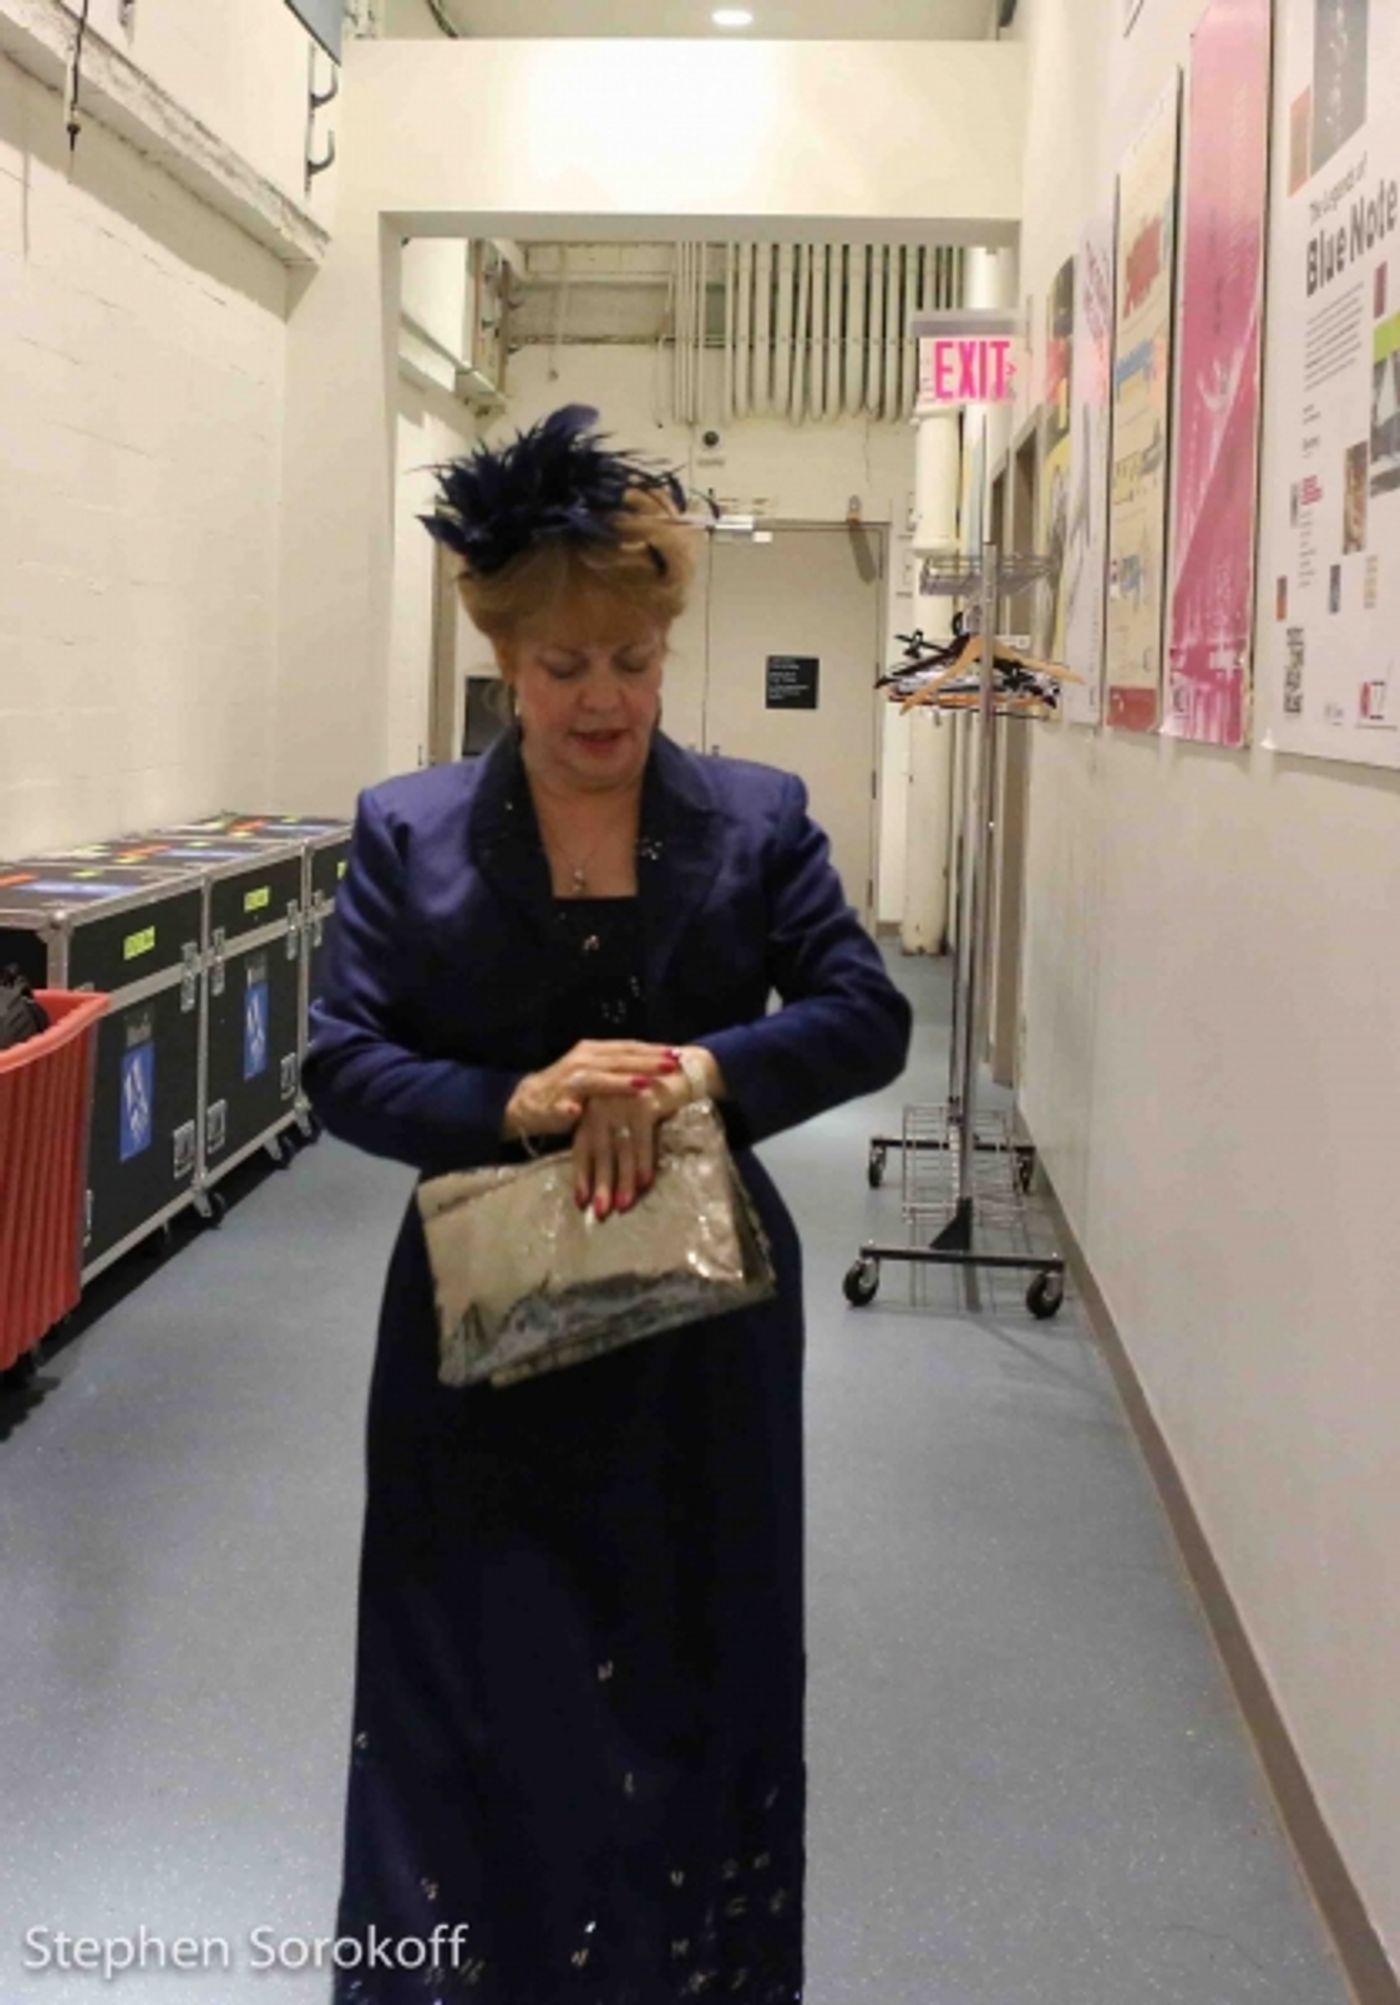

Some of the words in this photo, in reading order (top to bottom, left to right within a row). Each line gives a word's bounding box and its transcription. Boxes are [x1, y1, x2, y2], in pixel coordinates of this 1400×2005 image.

[1306, 226, 1346, 298] Blue
[1350, 178, 1398, 262] Note
[935, 340, 1010, 399] EXIT
